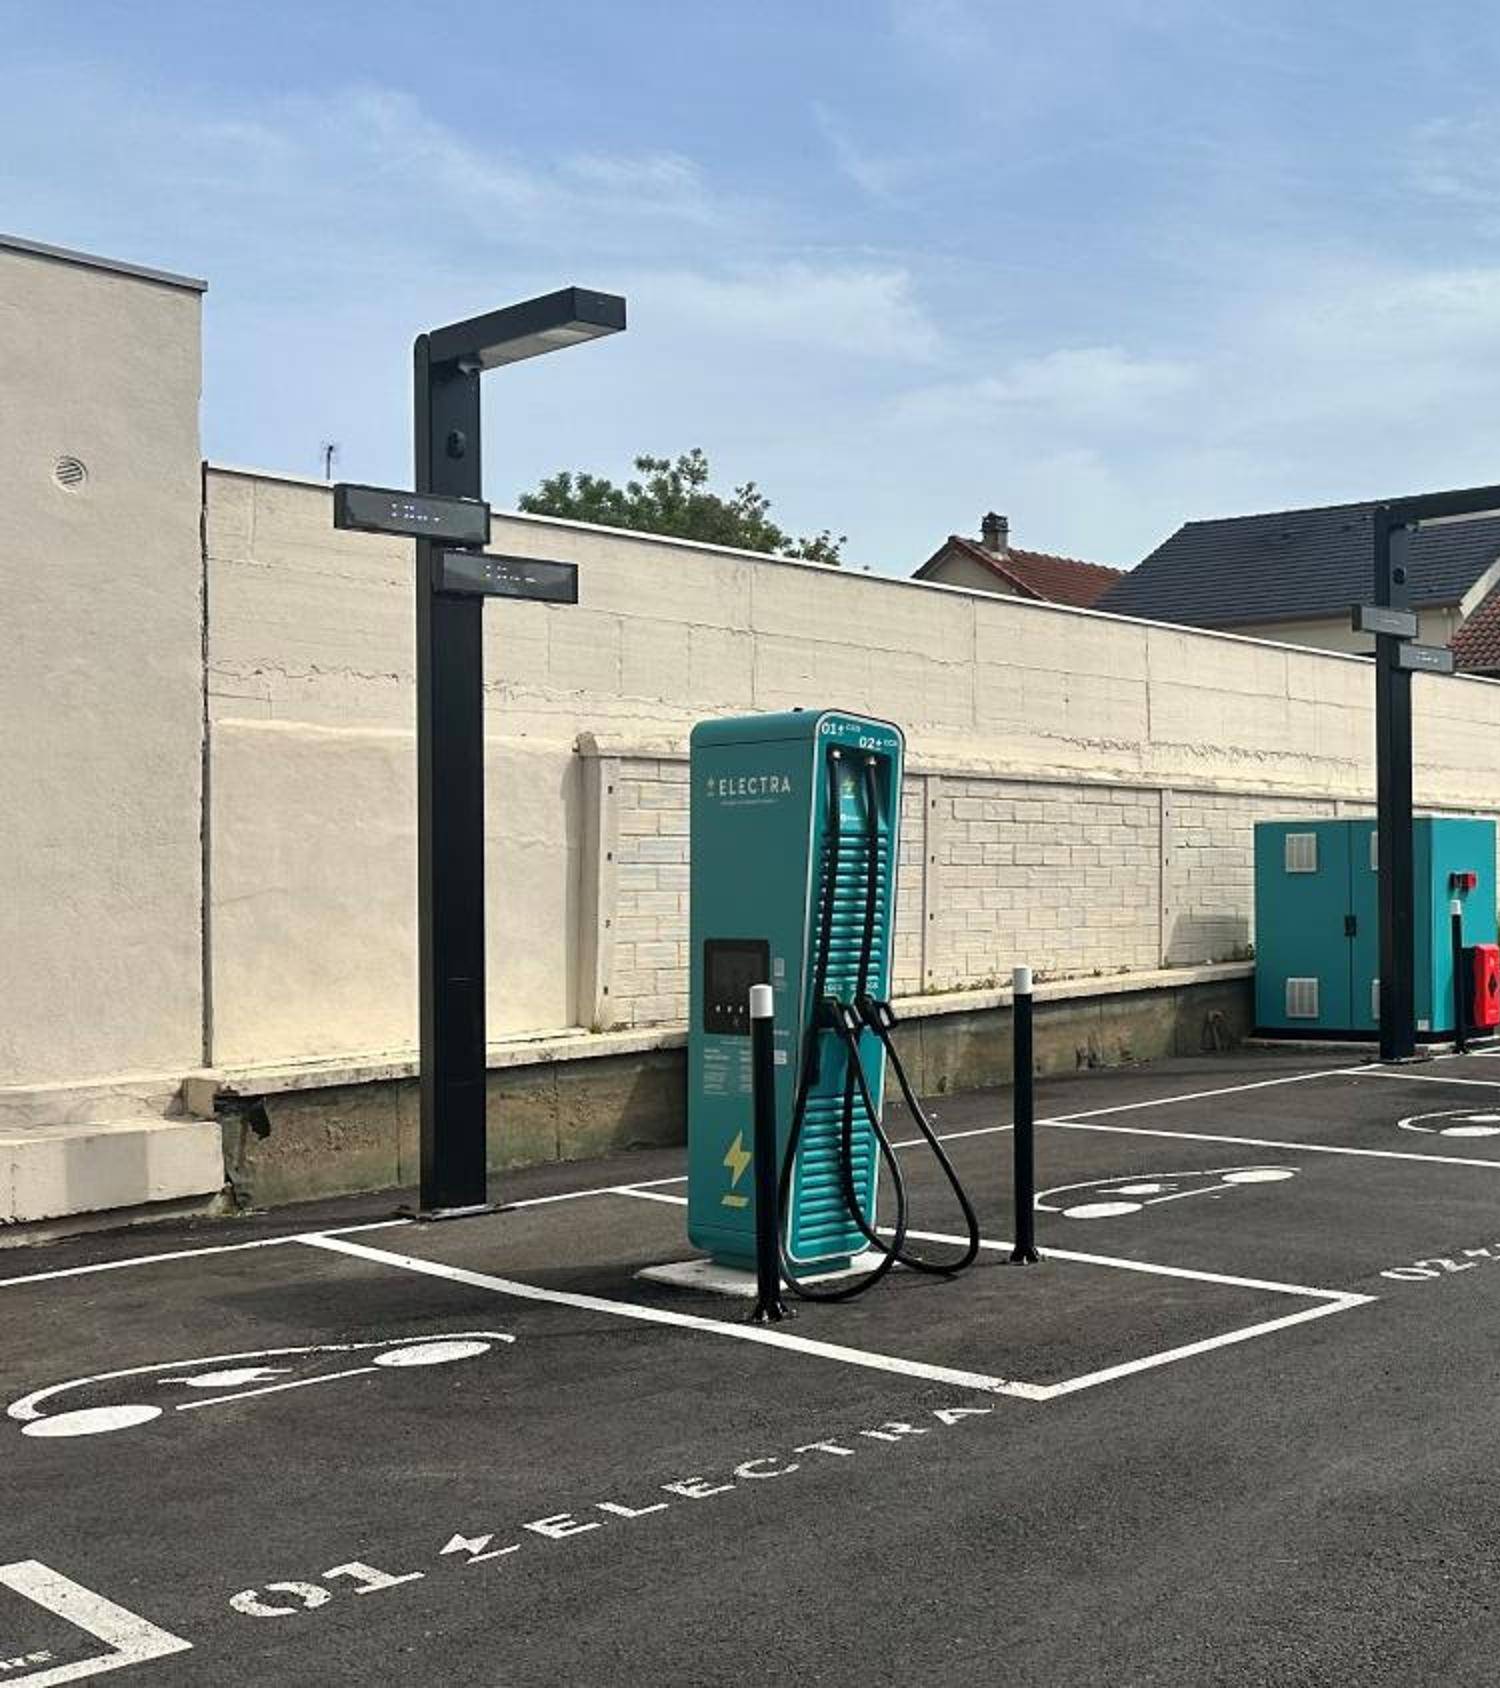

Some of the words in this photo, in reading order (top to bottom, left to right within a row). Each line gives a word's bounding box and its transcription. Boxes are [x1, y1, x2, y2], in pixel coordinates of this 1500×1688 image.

[821, 722, 837, 735] 01
[860, 736, 875, 749] 02
[719, 776, 791, 796] ELECTRA
[1379, 1258, 1480, 1281] 02
[229, 1560, 425, 1618] 01
[522, 1403, 995, 1540] ELECTRA
